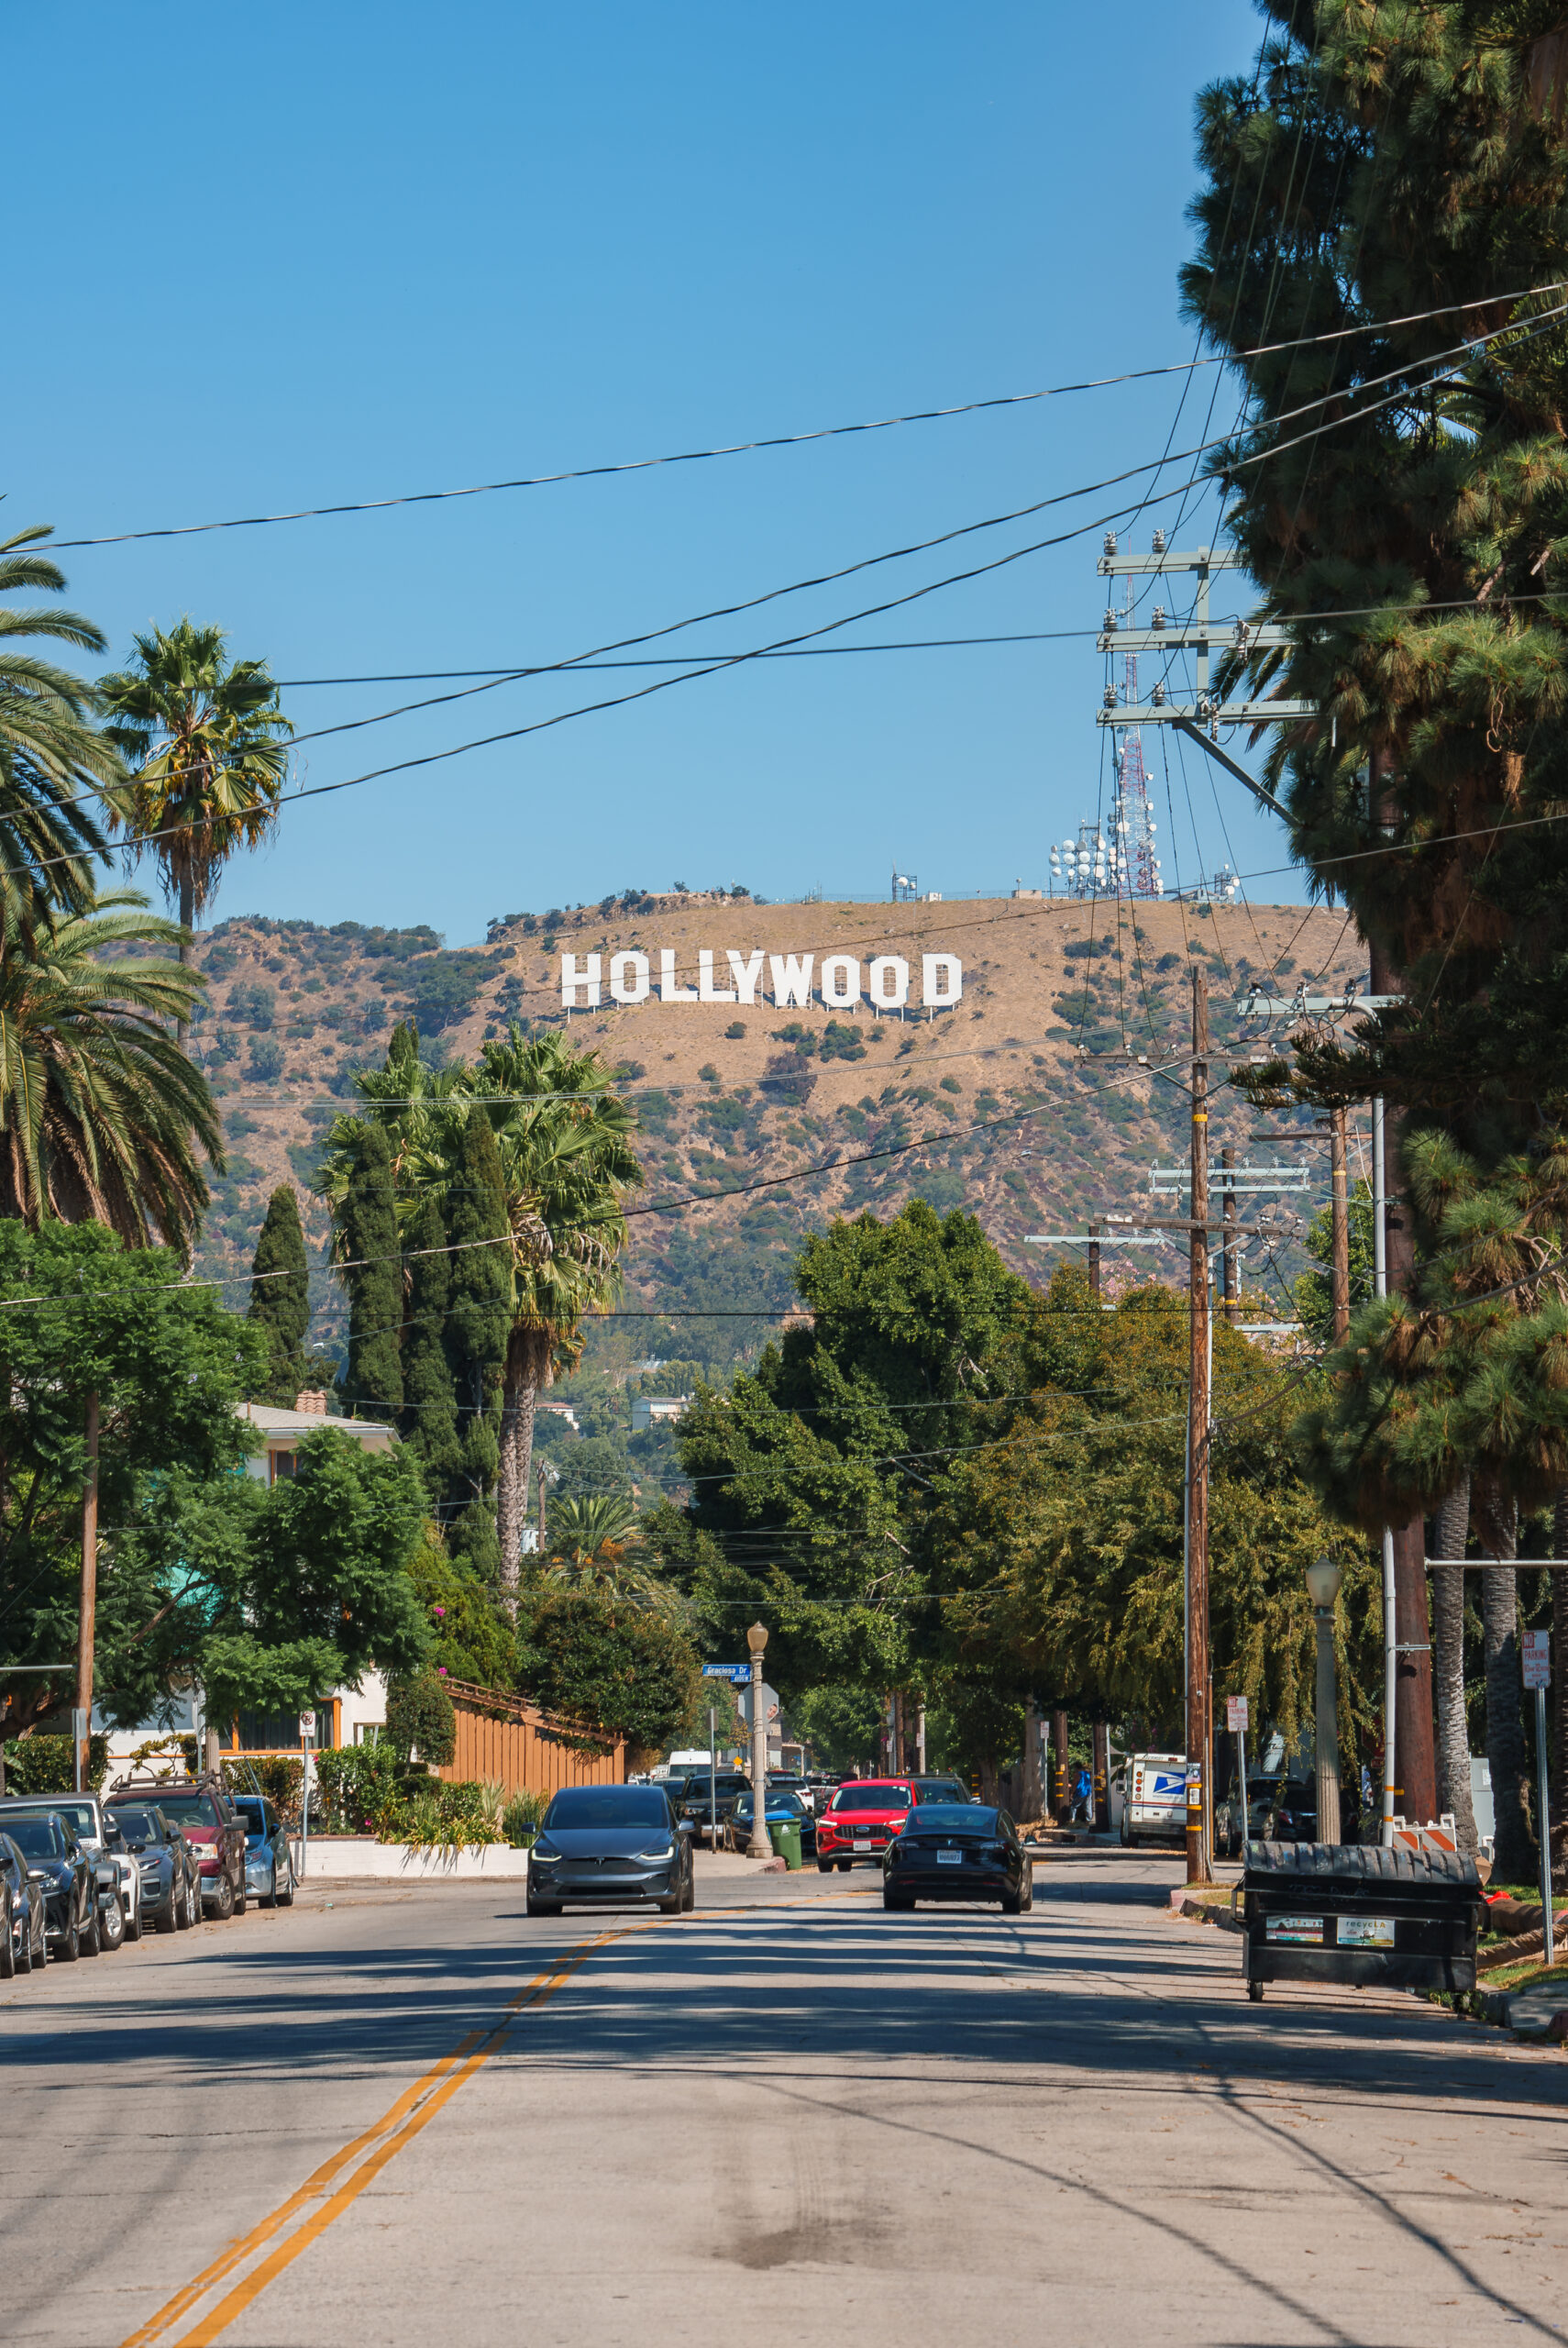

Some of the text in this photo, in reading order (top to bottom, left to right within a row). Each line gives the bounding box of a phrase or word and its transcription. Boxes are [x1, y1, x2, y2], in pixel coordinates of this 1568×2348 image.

[561, 948, 962, 1008] HOLLYWOOD
[1524, 1634, 1532, 1645] NO
[1524, 1649, 1547, 1659] PARKING
[707, 1666, 747, 1675] Graciosa Dr
